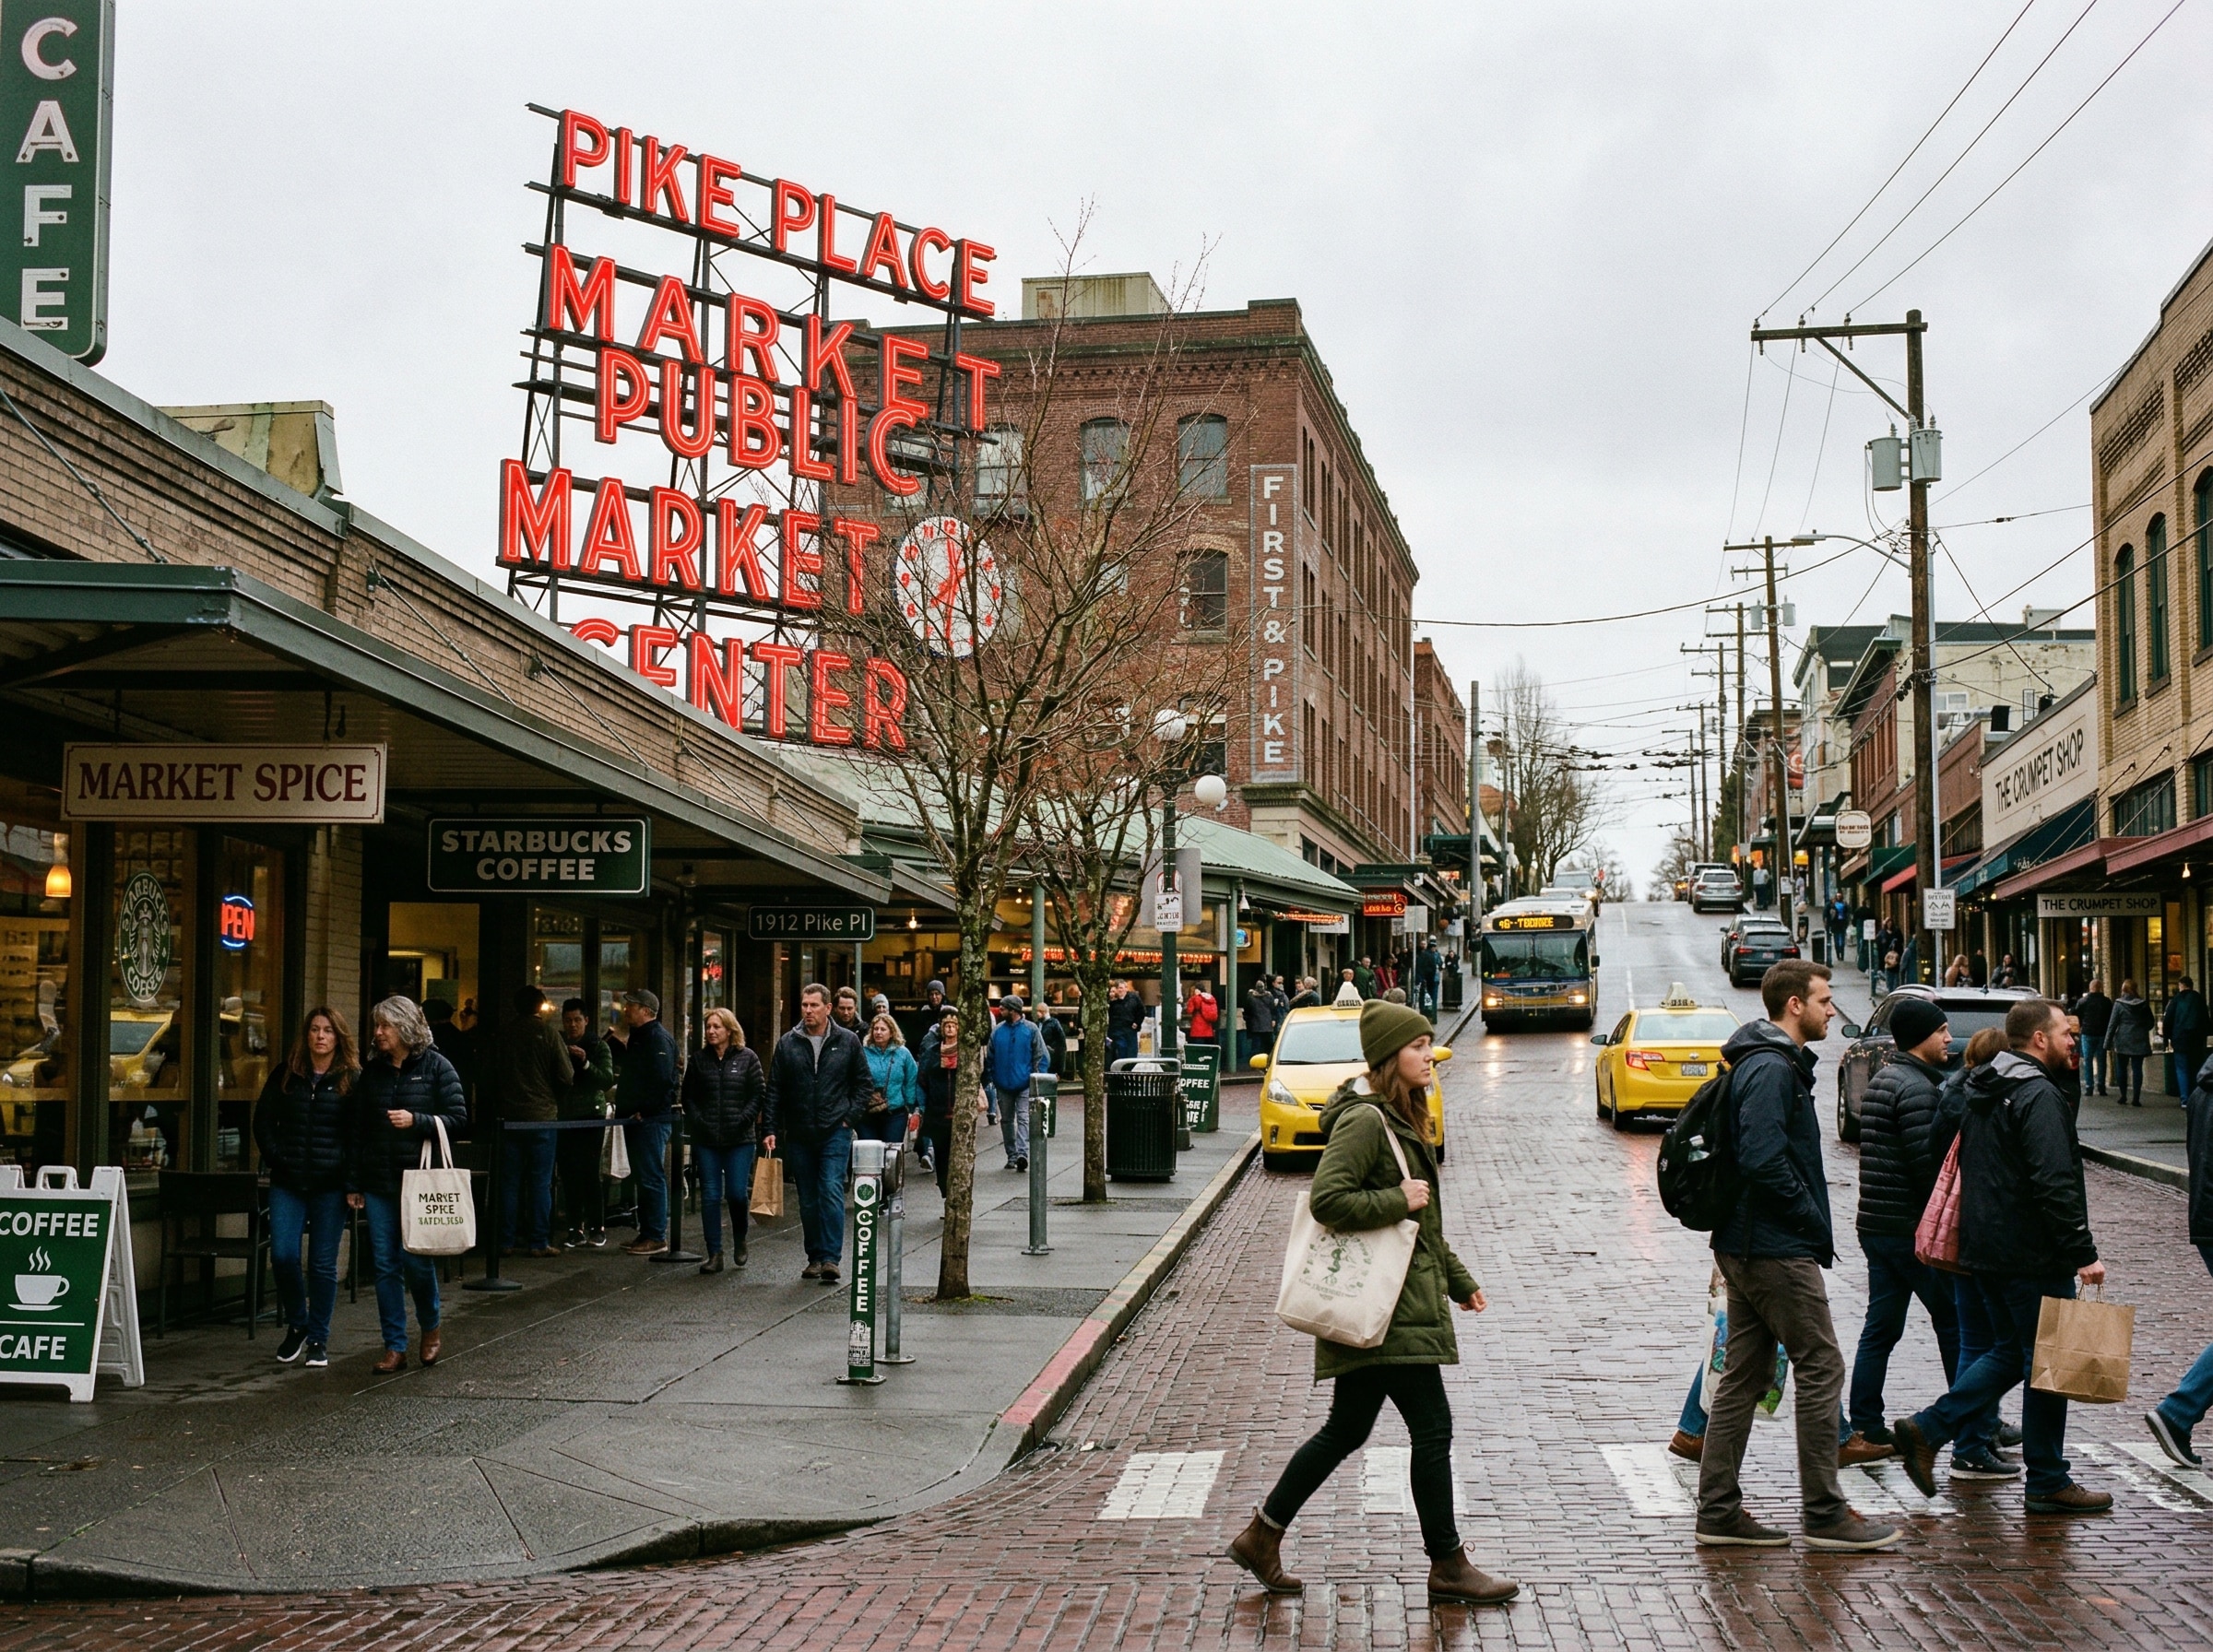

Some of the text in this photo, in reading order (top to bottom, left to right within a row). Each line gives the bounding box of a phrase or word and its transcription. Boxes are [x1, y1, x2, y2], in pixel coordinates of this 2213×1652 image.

[15, 17, 80, 331] CAFE
[561, 109, 997, 317] PIKE PLACE
[543, 242, 1001, 431] MARKET
[595, 347, 921, 496] PUBLIC
[499, 458, 879, 615] MARKET
[1262, 476, 1286, 764] FIRST & PIKE
[568, 618, 909, 752] ENTER
[78, 762, 367, 802] MARKET SPICE
[1994, 727, 2084, 813] THE CRUMPET SHOP
[442, 830, 633, 854] STARBUCKS
[476, 857, 596, 881] COFFEE
[755, 914, 867, 931] 1912 Pike Pl
[2042, 897, 2158, 912] THE CRUMPET SHOP
[0, 1210, 100, 1238] COFFEE
[856, 1210, 873, 1313] COFFEE
[0, 1334, 67, 1361] CAFE
